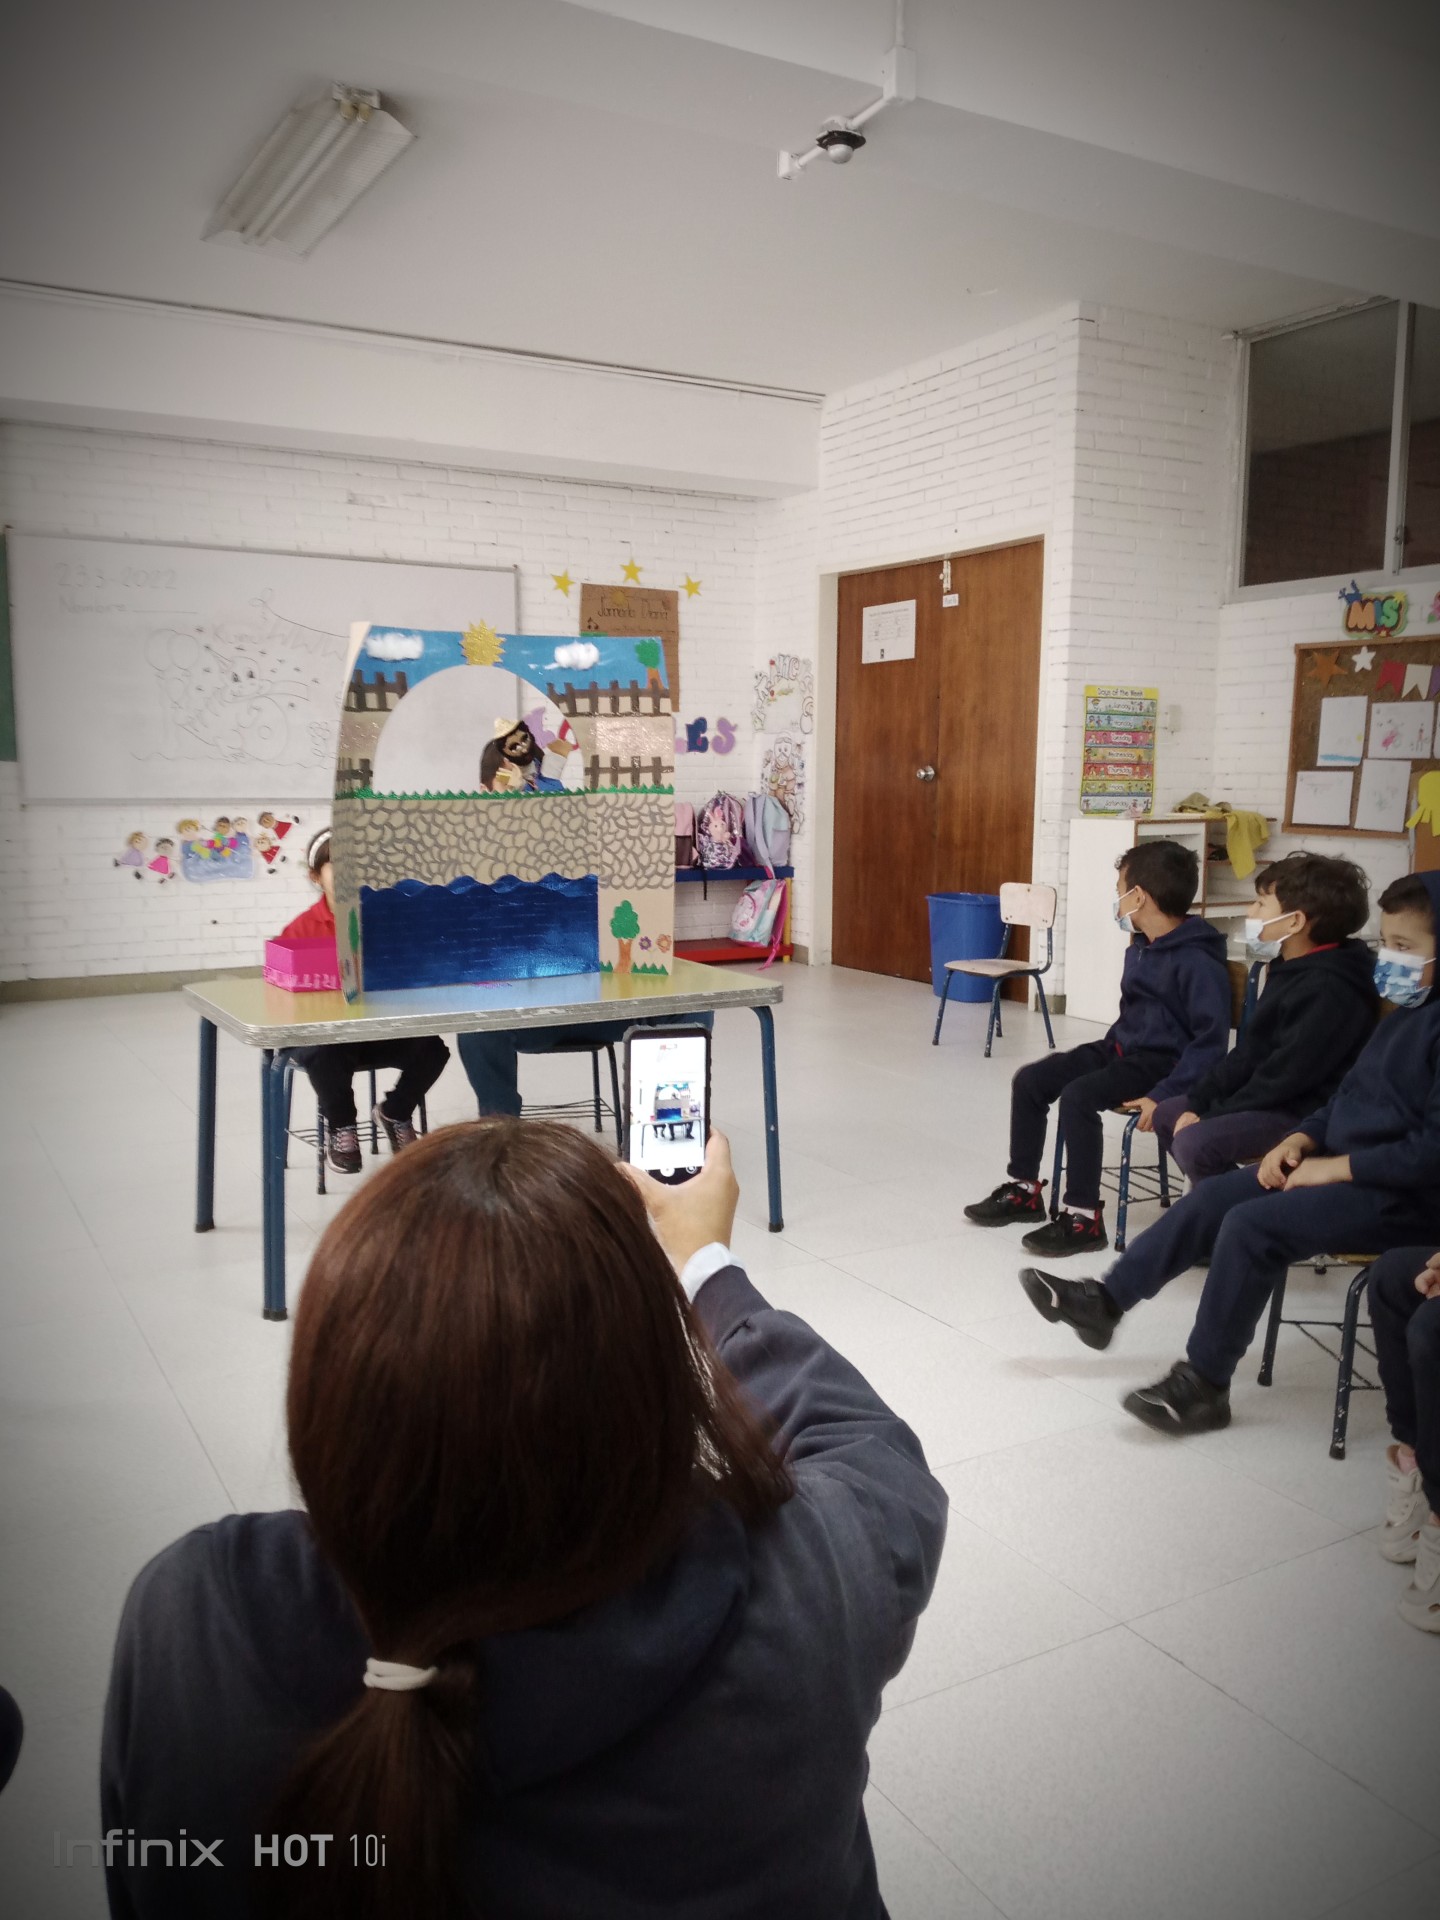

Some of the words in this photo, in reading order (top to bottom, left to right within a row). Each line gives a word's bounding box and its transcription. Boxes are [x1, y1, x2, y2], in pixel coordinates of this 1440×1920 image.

[1348, 600, 1398, 630] MIS
[1097, 687, 1111, 696] Days
[1112, 688, 1119, 696] of
[1108, 751, 1135, 759] Wednesday
[1108, 766, 1132, 774] Thursday
[1104, 800, 1129, 809] Saturday
